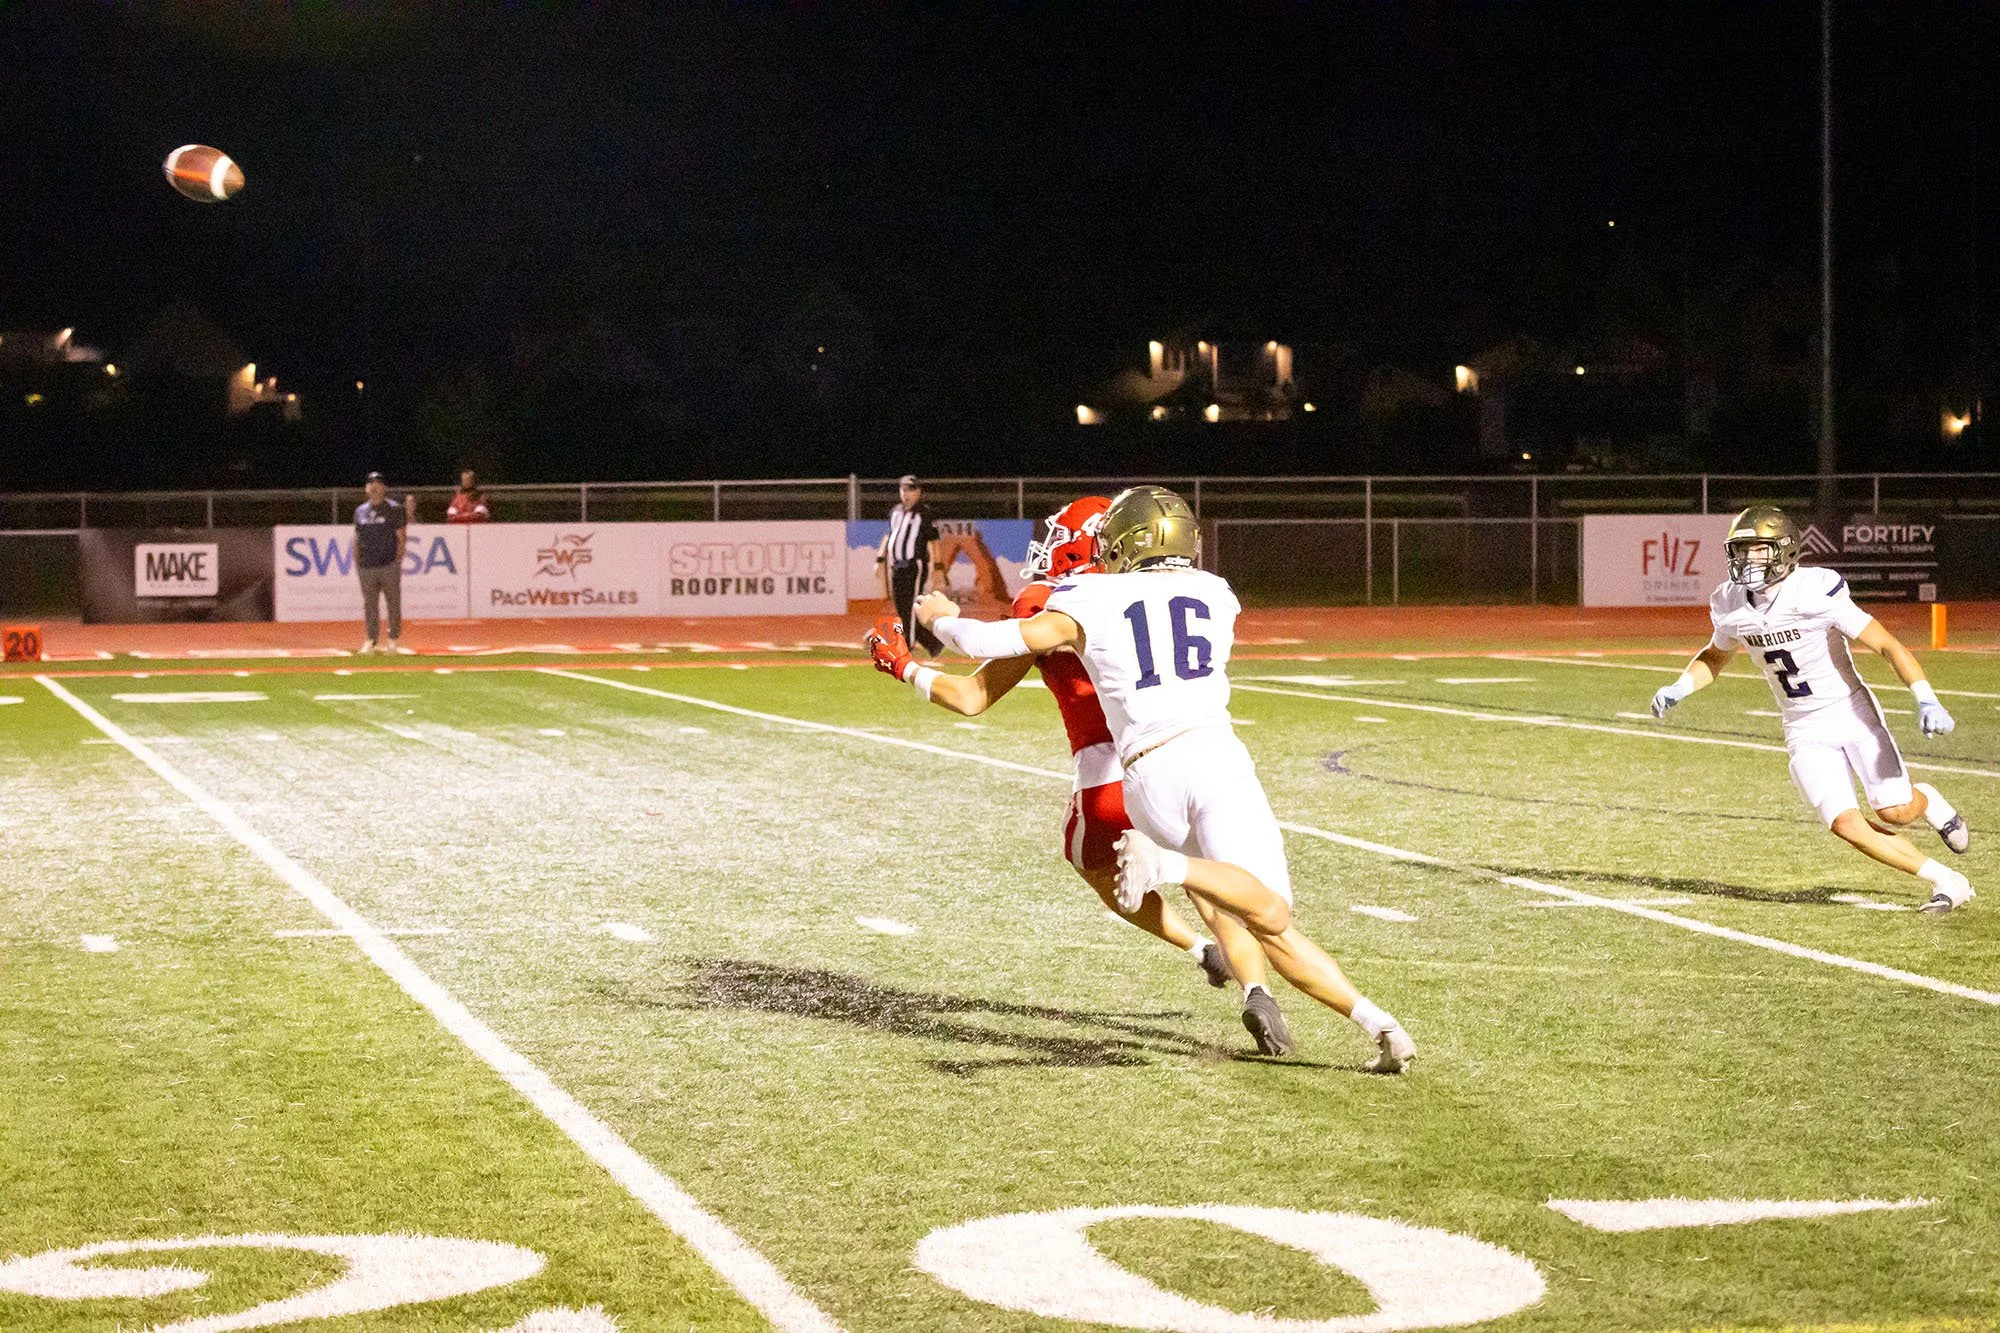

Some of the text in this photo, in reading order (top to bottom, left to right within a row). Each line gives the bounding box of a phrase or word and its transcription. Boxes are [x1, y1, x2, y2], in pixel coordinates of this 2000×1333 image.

[1843, 525, 1936, 543] FORTIFY
[146, 552, 207, 581] MAKE
[286, 536, 457, 576] SWSA
[669, 541, 834, 576] STOUT
[671, 577, 834, 596] ROOFING INC.
[7, 631, 37, 657] 20
[1123, 596, 1214, 690] 16
[1743, 628, 1801, 648] WARRIORS
[1763, 649, 1813, 698] 2
